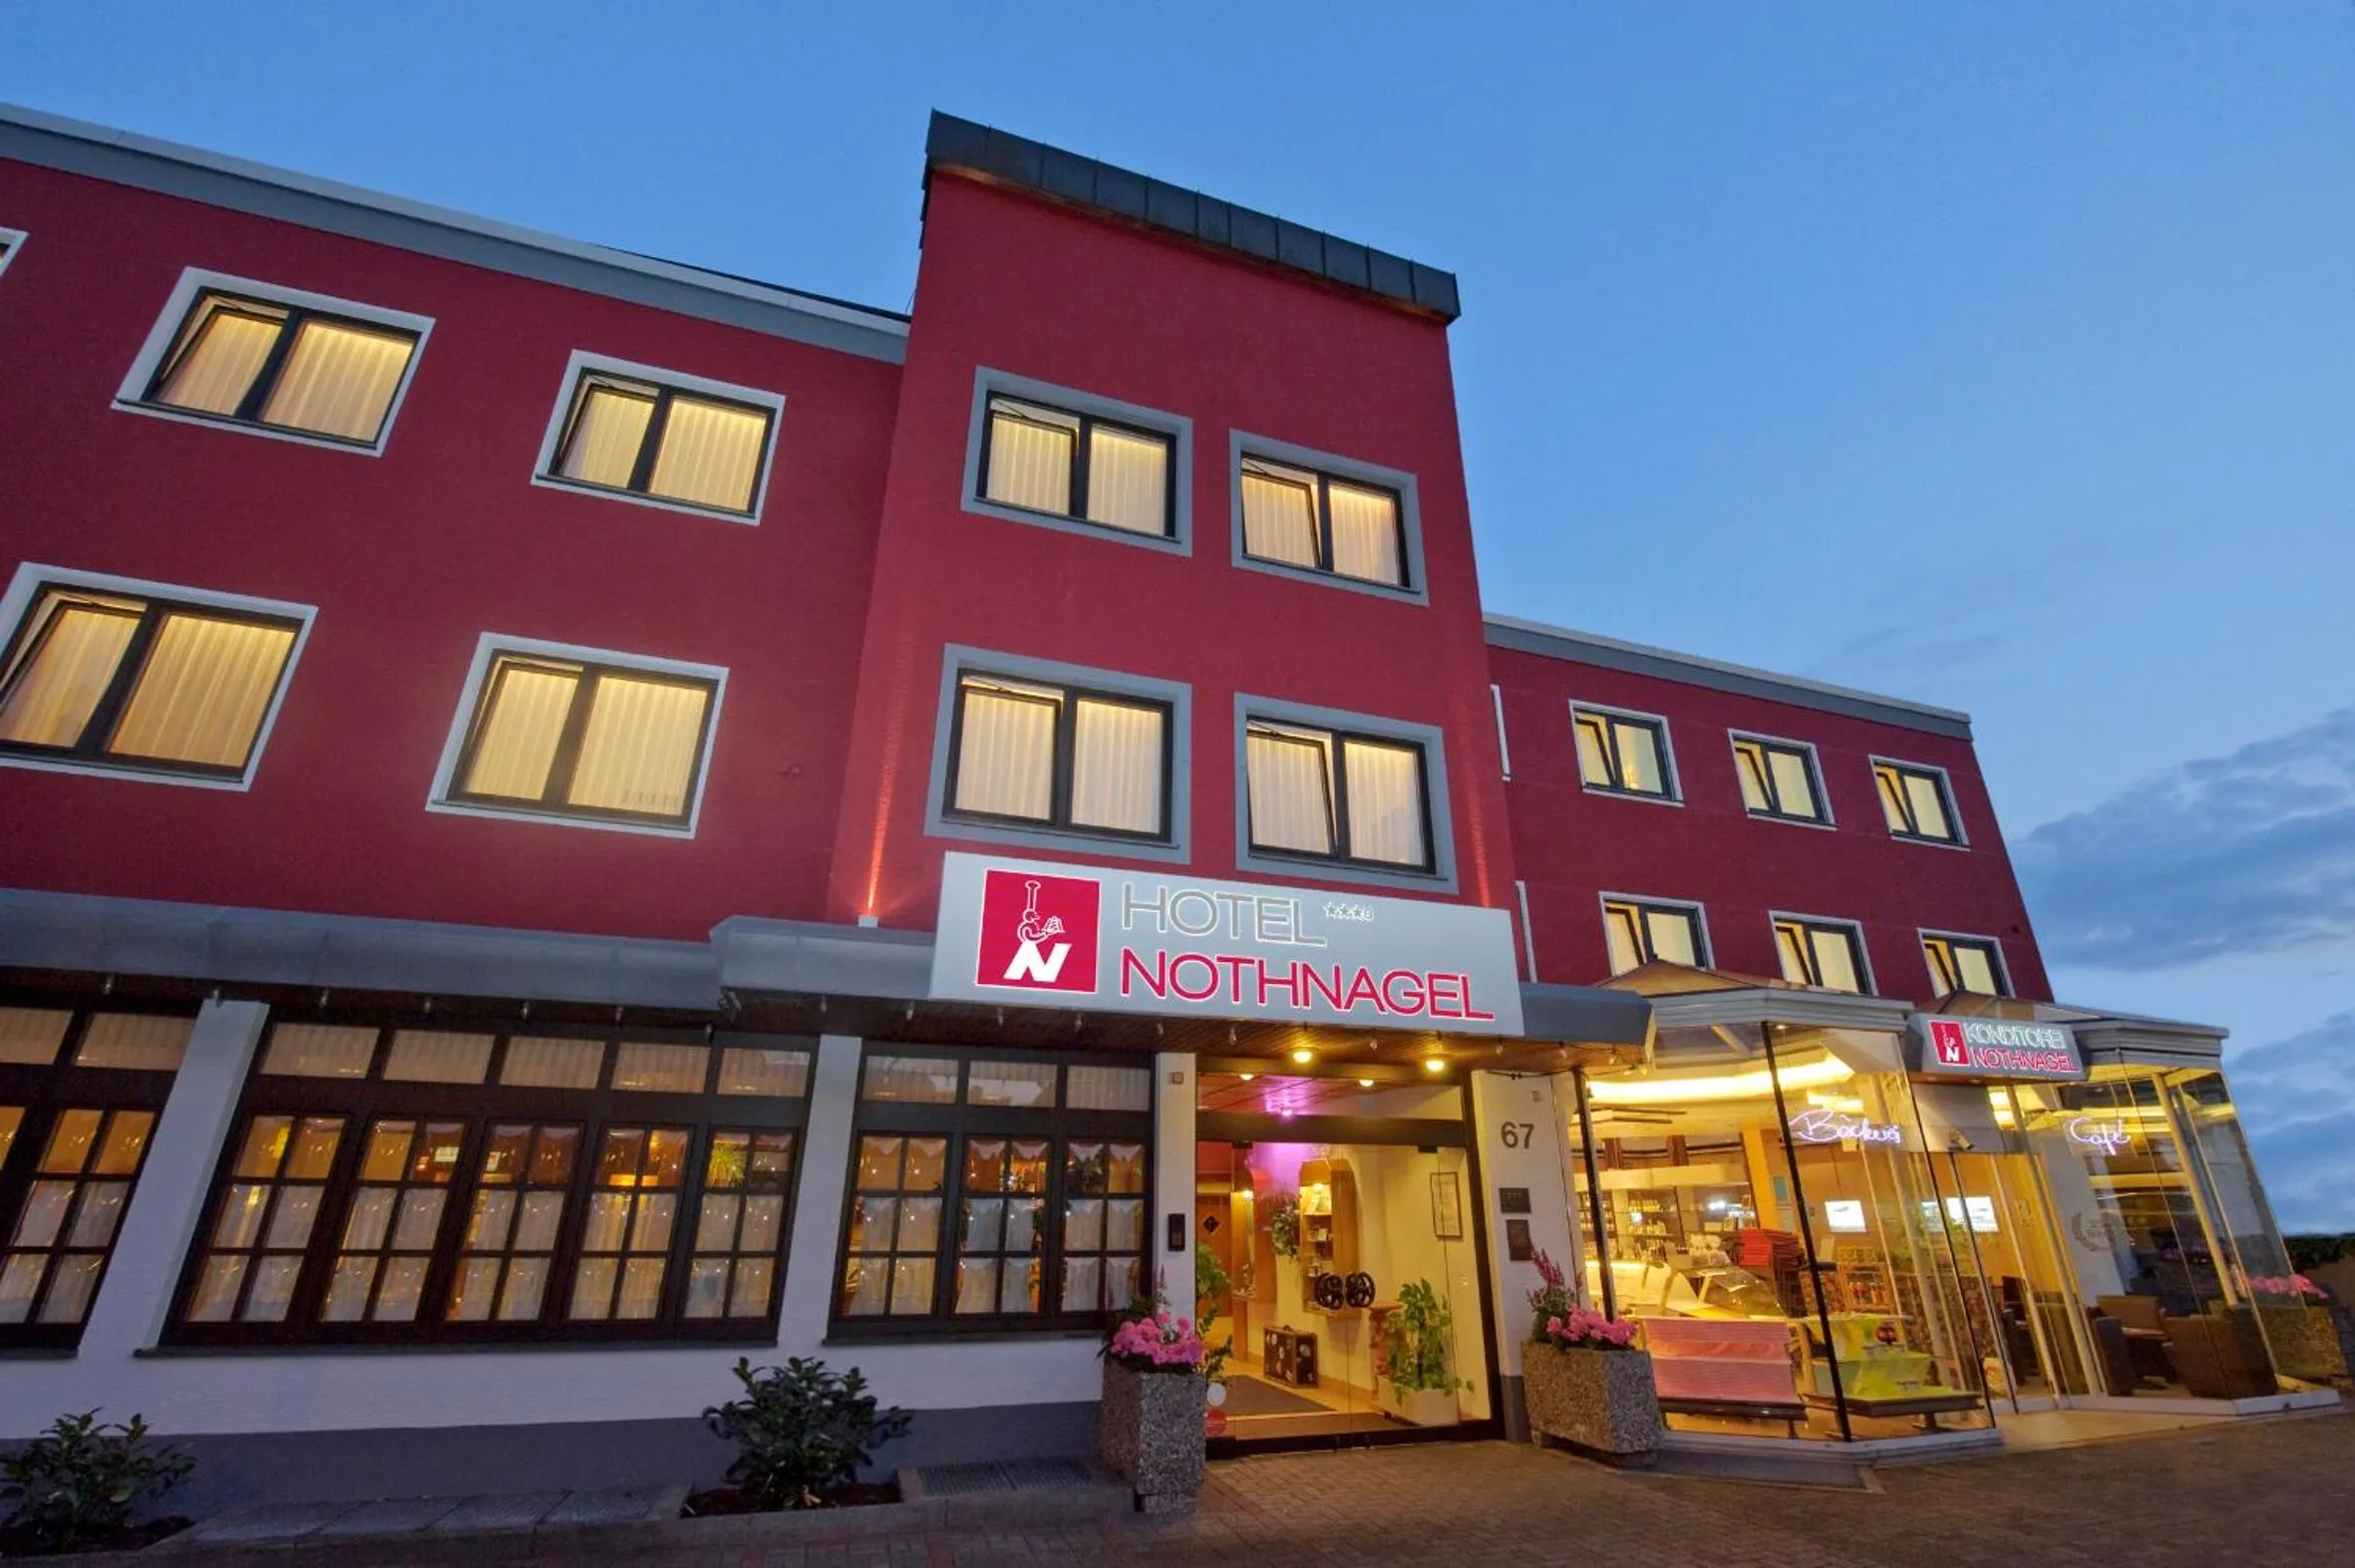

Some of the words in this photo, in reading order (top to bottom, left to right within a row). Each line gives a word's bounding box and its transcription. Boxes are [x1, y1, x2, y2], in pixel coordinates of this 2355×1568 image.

[1122, 881, 1328, 948] HOTEL
[1003, 940, 1073, 983] N
[1121, 947, 1495, 1021] NOTHNAGEL
[1970, 1049, 2081, 1073] NOTHNAGEL
[1501, 1121, 1534, 1148] 67
